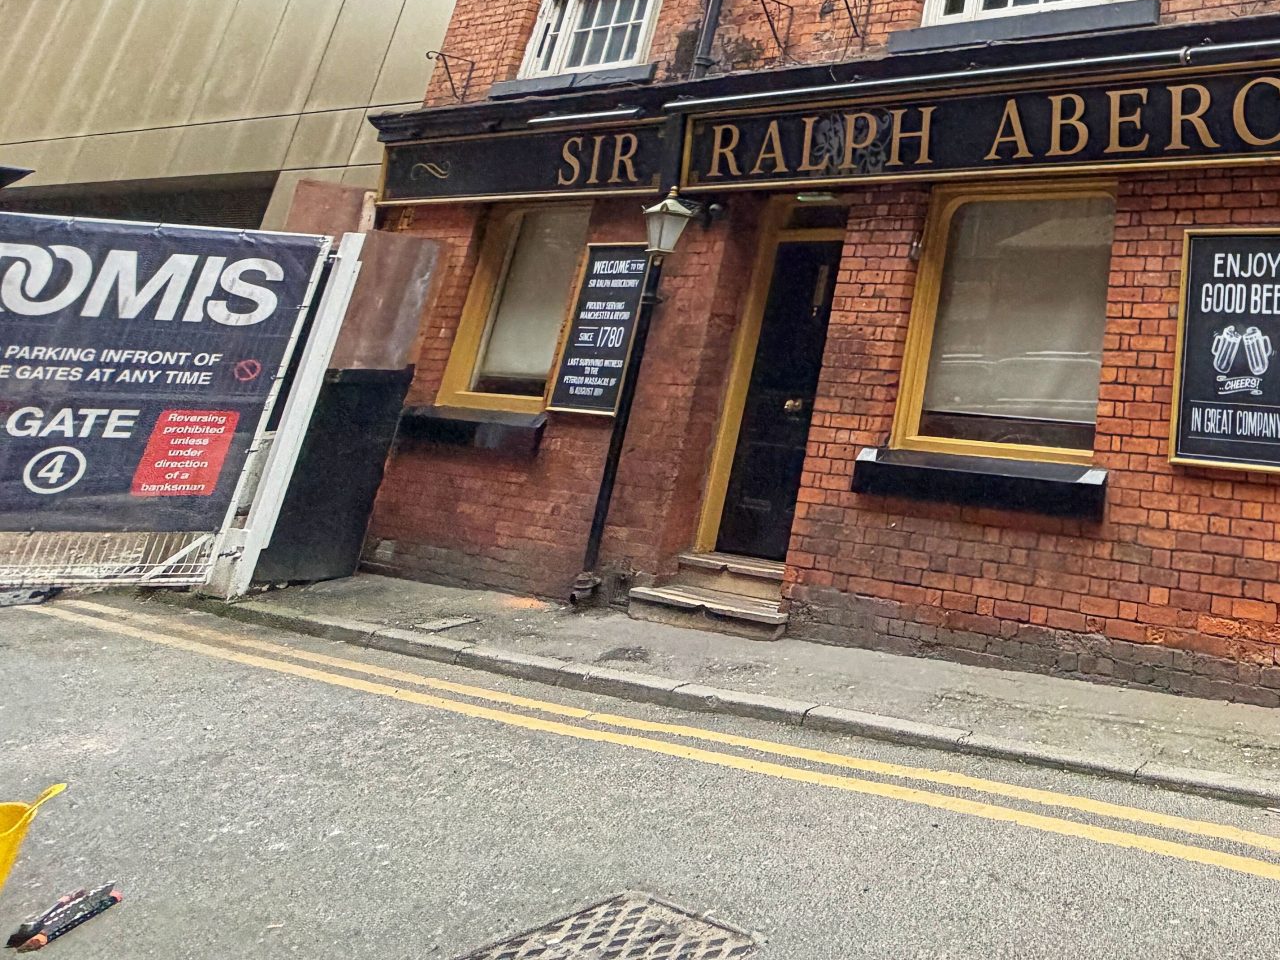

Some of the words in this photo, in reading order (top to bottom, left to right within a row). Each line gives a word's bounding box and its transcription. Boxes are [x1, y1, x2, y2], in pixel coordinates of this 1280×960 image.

[558, 132, 640, 187] SIR
[706, 106, 938, 178] RALPH
[593, 260, 631, 274] WELCOME
[1201, 283, 1247, 314] GOOD
[578, 332, 595, 342] SINCE
[596, 326, 625, 348] 1780
[4, 345, 97, 362] PARKING
[99, 348, 192, 365] INFRONT
[193, 353, 224, 366] OF
[15, 365, 84, 381] GATES
[85, 368, 116, 382] AT
[115, 369, 163, 384] ANY
[165, 371, 214, 385] TIME
[5, 406, 140, 438] GATE
[168, 413, 227, 424] Reversing
[1191, 407, 1202, 432] IN
[1204, 408, 1234, 435] GREAT
[163, 425, 226, 434] prohibited
[170, 437, 210, 445] unless
[168, 448, 205, 457] under
[37, 454, 68, 484] 4
[154, 460, 209, 468] direction
[165, 471, 180, 480] of
[180, 472, 191, 480] a
[140, 483, 206, 491] banksman
